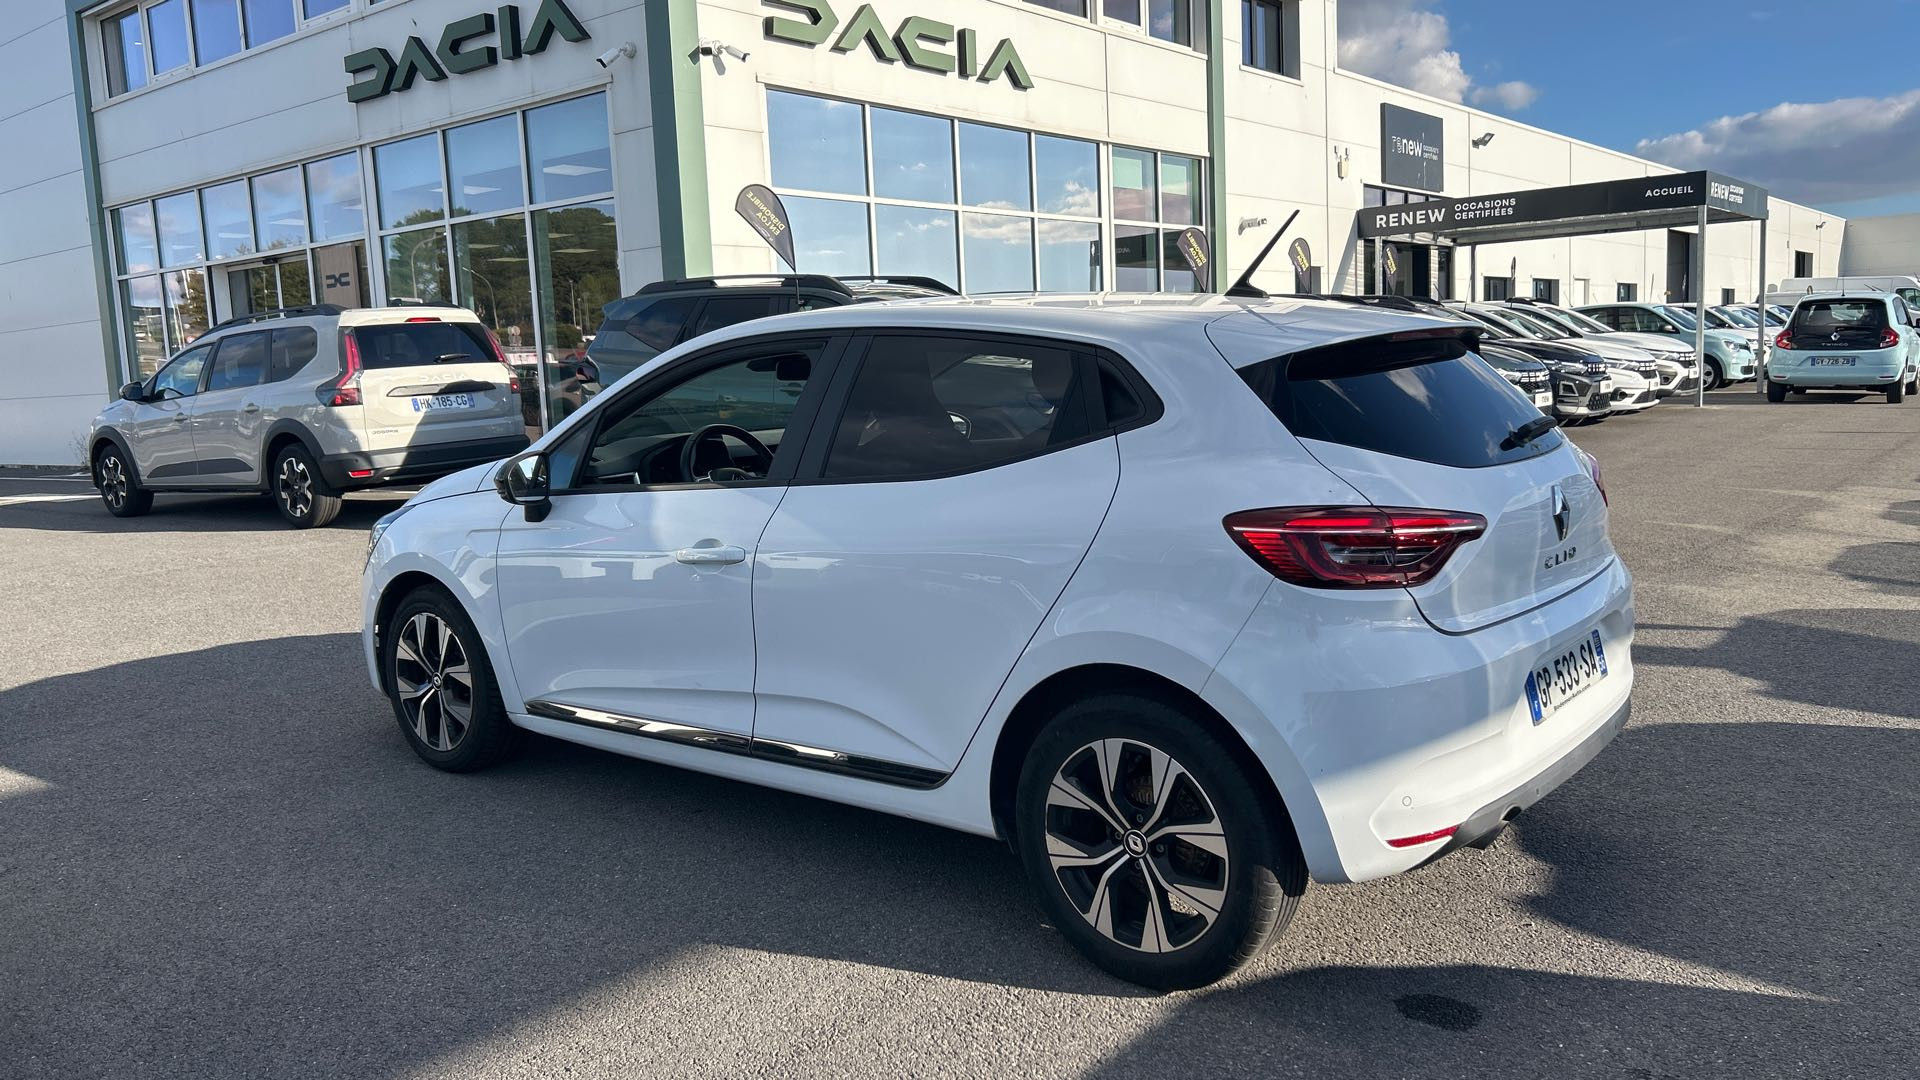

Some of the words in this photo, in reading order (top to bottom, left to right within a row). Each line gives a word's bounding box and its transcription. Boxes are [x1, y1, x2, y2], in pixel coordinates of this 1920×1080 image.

[344, 0, 592, 103] DACIA
[762, 0, 1035, 91] DACIA
[1645, 186, 1694, 197] ACCUEIL
[1711, 182, 1729, 200] RENEW
[1454, 198, 1516, 211] OCCASIONS
[1454, 207, 1514, 220] CERTIFIÉES
[1376, 208, 1446, 228] RENEW
[1544, 546, 1577, 569] CLIO
[1536, 640, 1599, 708] GP-533-SA
